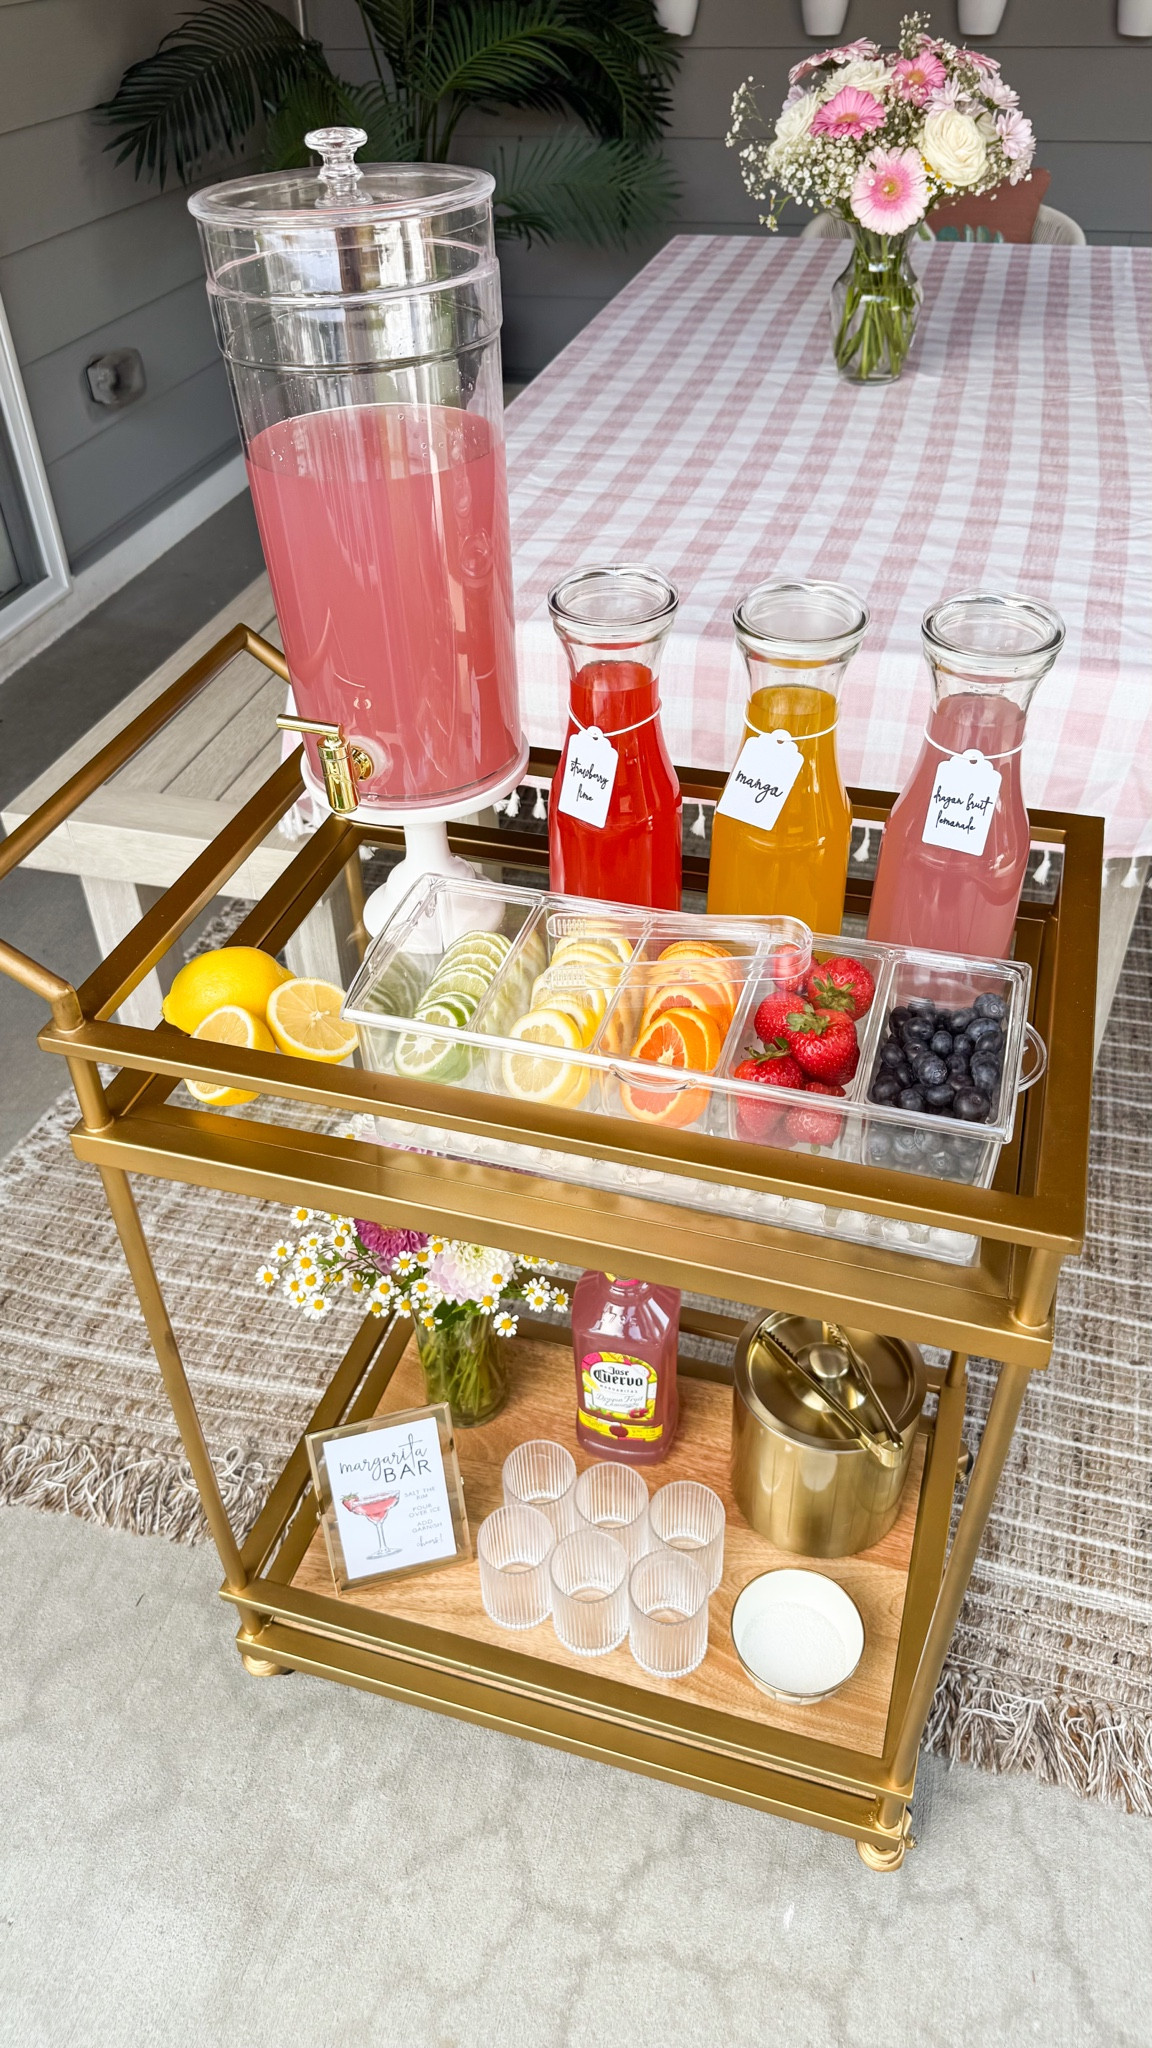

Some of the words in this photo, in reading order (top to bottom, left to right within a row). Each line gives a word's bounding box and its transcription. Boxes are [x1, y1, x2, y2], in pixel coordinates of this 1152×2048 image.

[966, 793, 993, 816] fruit
[593, 1369, 643, 1387] Cuervo
[340, 1433, 427, 1481] margarita
[383, 1460, 432, 1483] BAR
[408, 1510, 427, 1518] OVER
[417, 1518, 433, 1526] ADD
